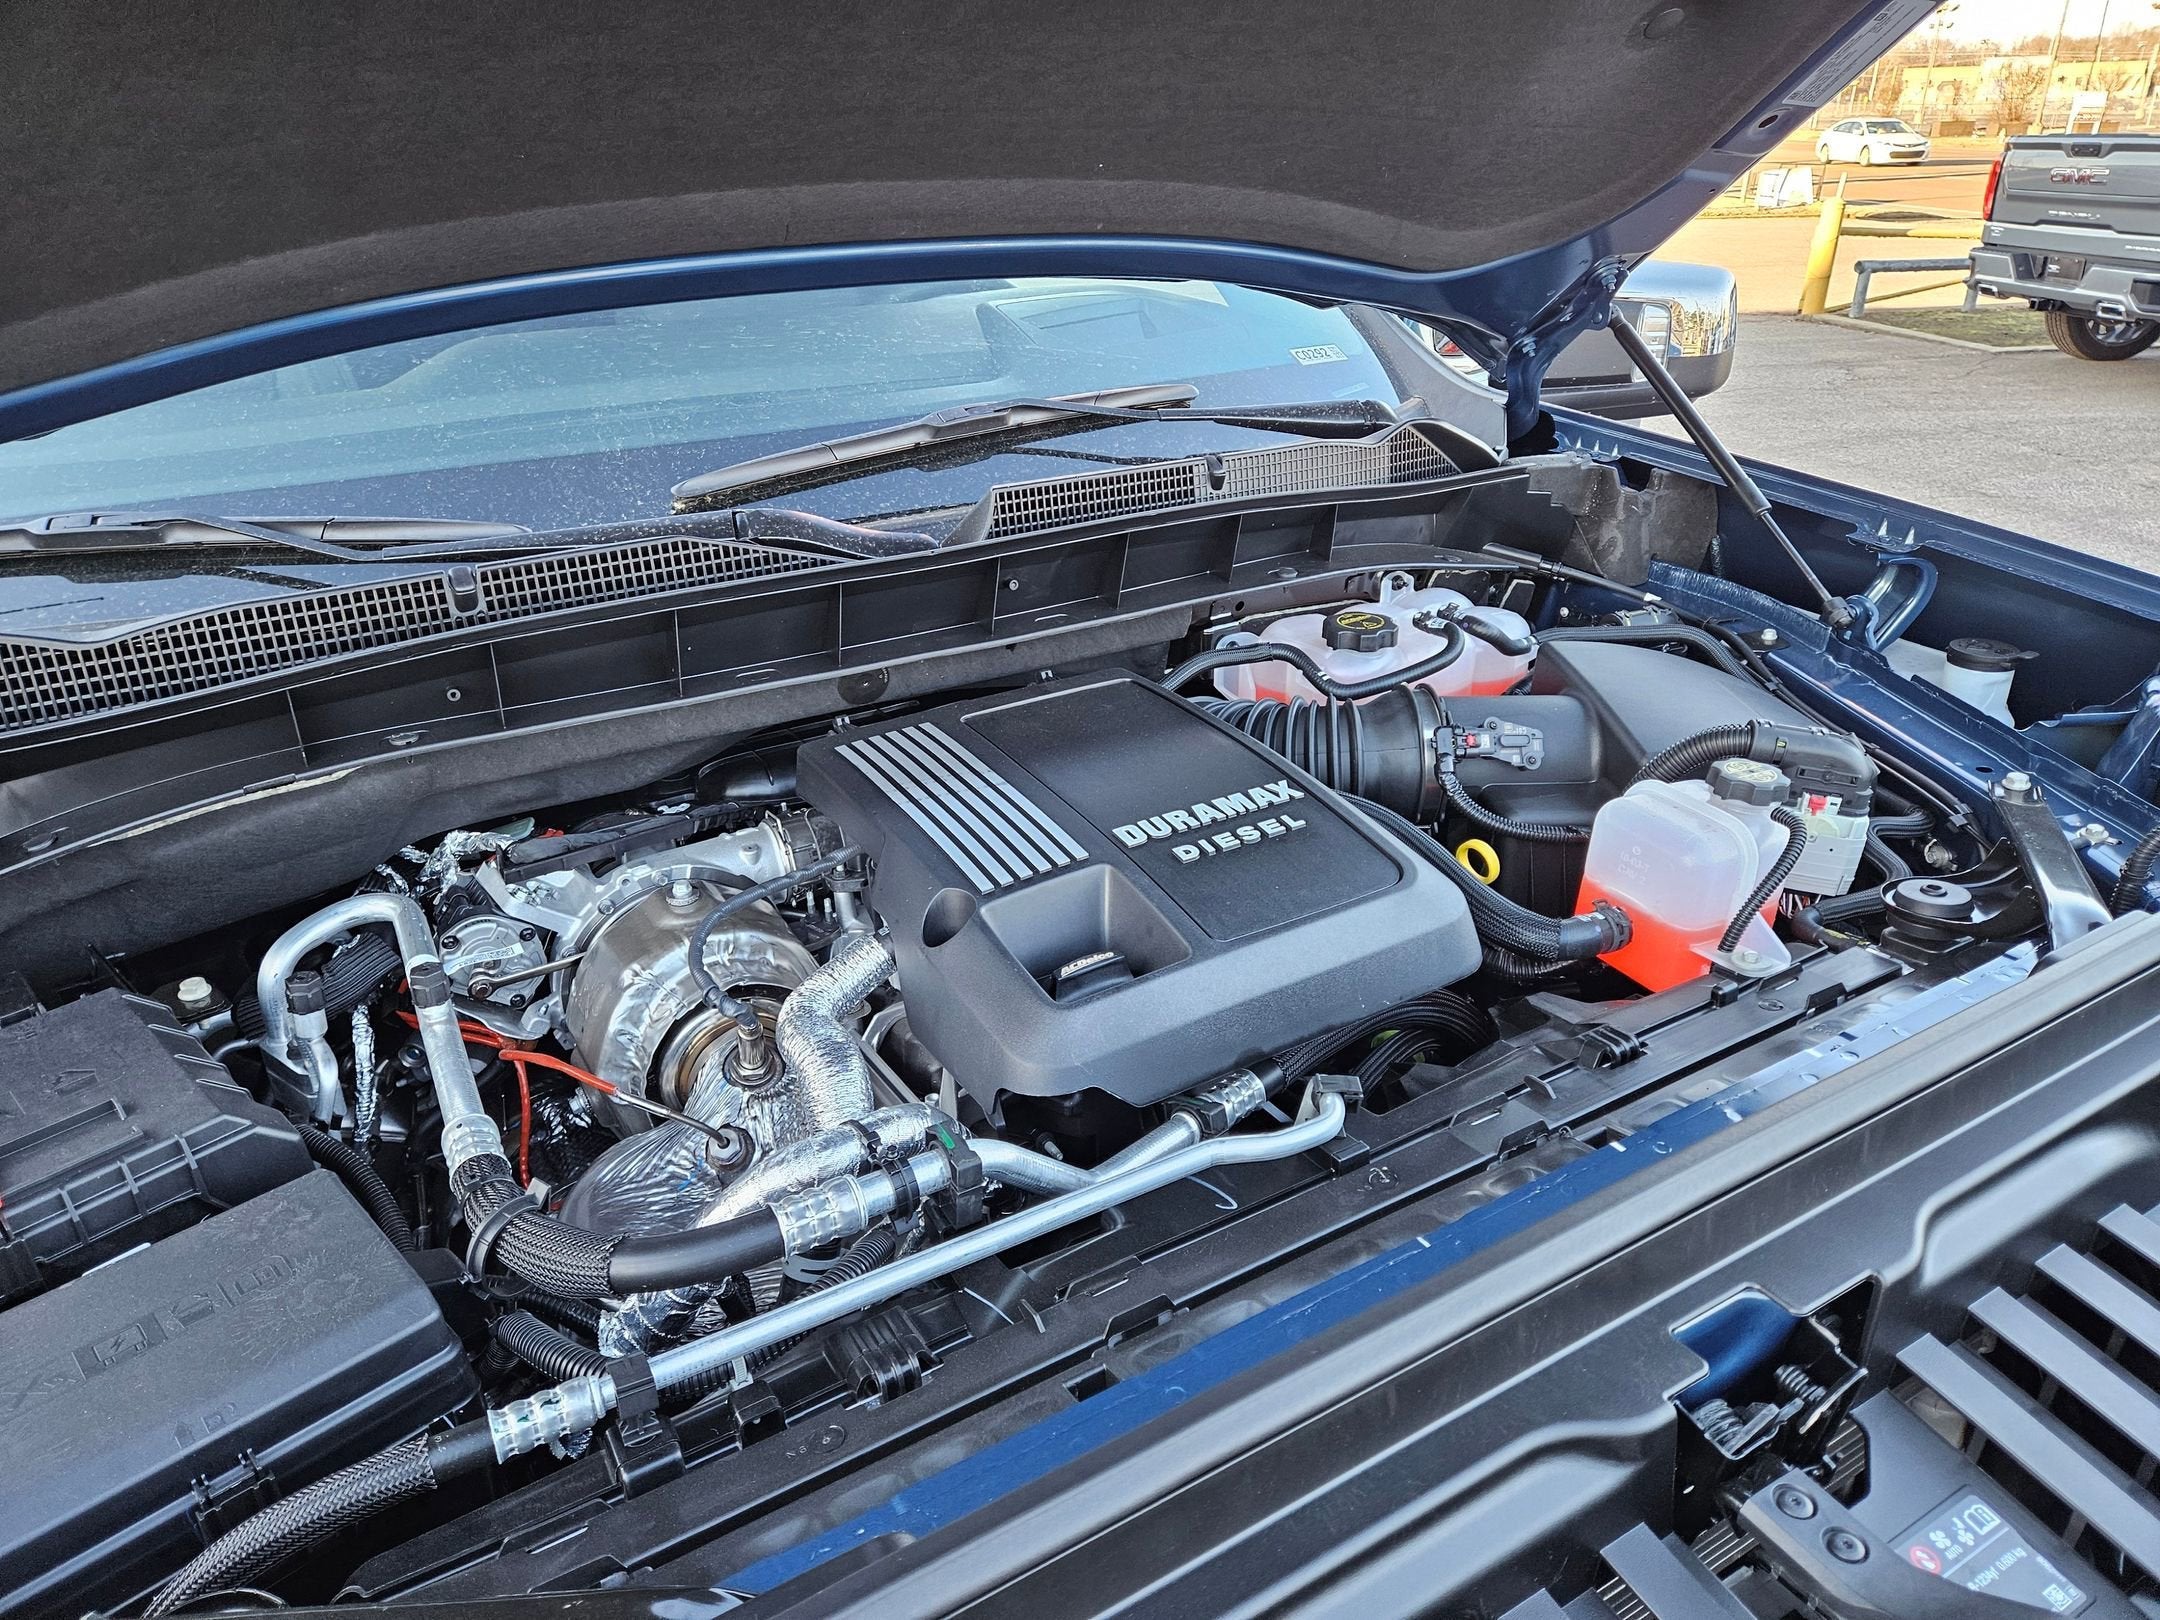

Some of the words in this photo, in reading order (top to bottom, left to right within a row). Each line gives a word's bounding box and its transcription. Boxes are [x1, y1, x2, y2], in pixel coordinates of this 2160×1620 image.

[2050, 167, 2110, 185] GMC
[1295, 347, 1331, 360] C0292
[1112, 779, 1305, 848] DURAMAX
[1172, 814, 1306, 864] DIESEL
[1061, 951, 1115, 978] ACDelco
[1944, 1544, 1964, 1561] AUTO
